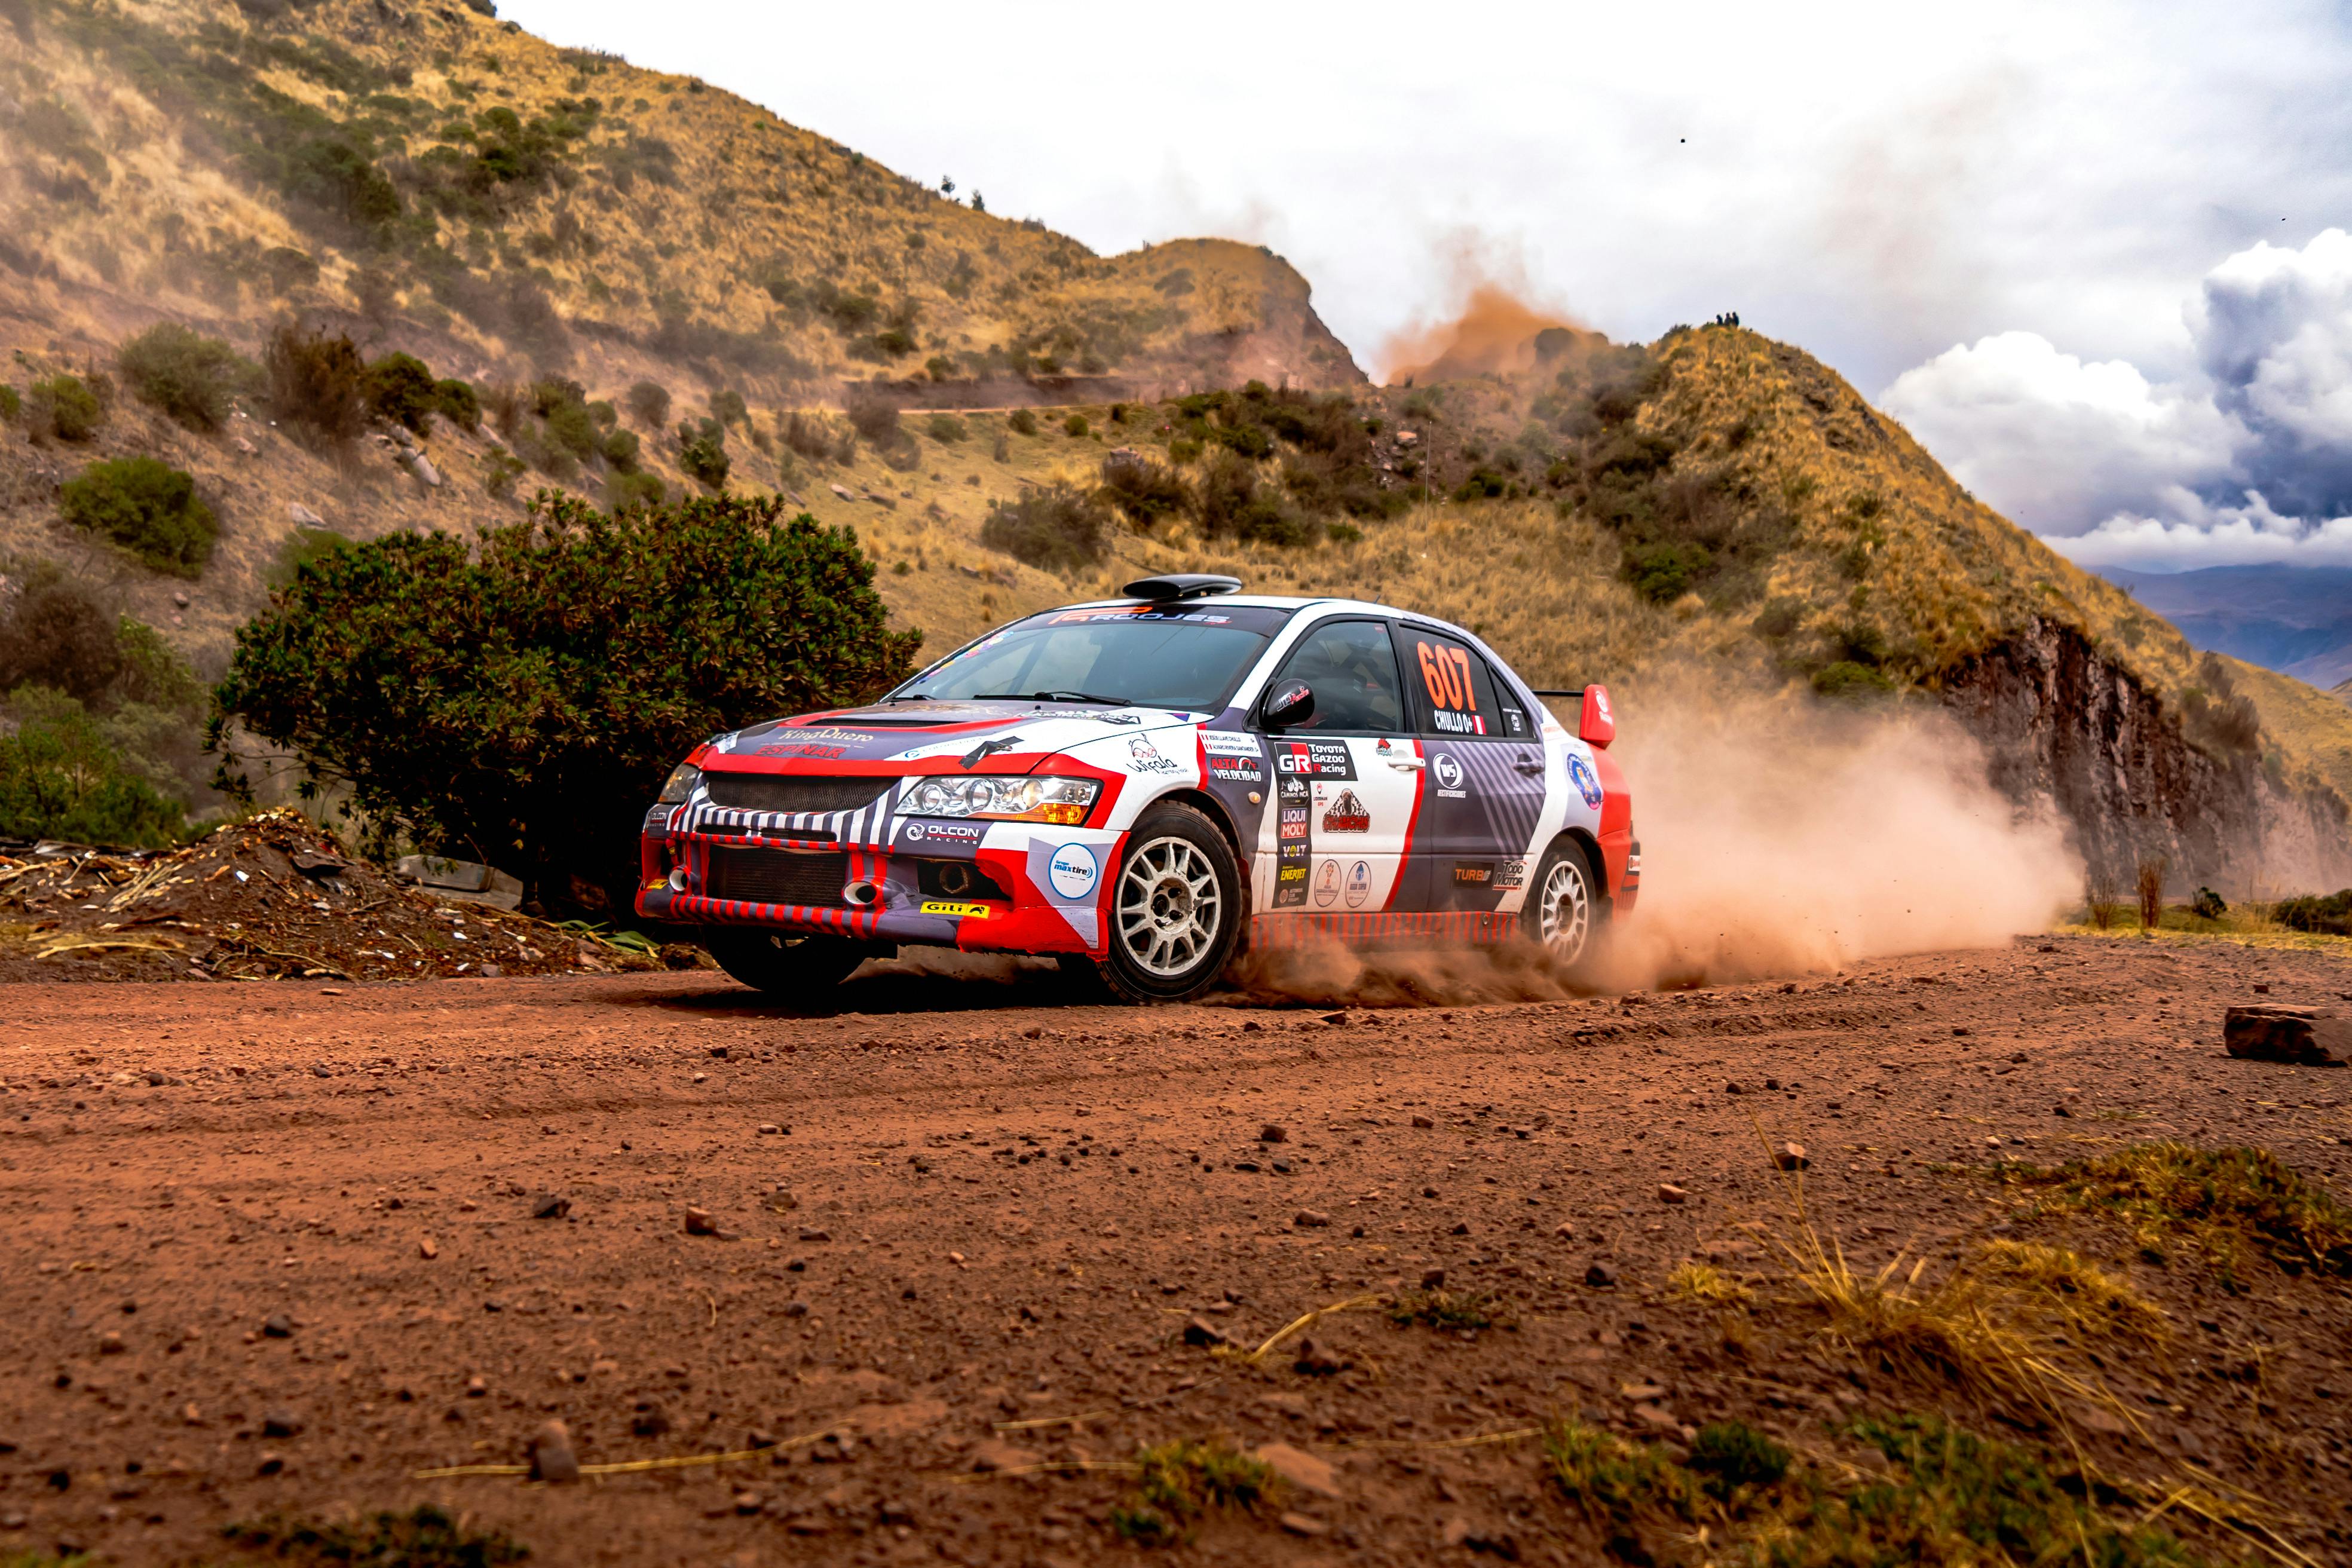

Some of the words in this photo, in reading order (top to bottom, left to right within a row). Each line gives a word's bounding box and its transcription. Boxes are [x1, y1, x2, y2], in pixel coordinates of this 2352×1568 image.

[1417, 641, 1477, 711] 607
[1434, 710, 1463, 733] CHULLO
[755, 743, 847, 759] ESPINAR
[1279, 754, 1310, 771] GR
[1308, 744, 1346, 754] TOYOTA
[1211, 758, 1239, 770] ALTA
[1312, 754, 1345, 763] GAZOO
[1213, 769, 1261, 782] VELOCIDAD
[1313, 763, 1346, 776] Racing
[1440, 764, 1456, 777] WS
[1283, 810, 1306, 823] LIQUI
[927, 825, 979, 838] OLCON
[1281, 823, 1306, 837] MOLY
[1283, 844, 1307, 858] VOLT
[1054, 864, 1088, 875] maxtire
[1502, 860, 1524, 874] TODO
[1281, 868, 1306, 882] ENERJET
[1494, 872, 1524, 886] MOTOR
[927, 904, 963, 912] Gili
